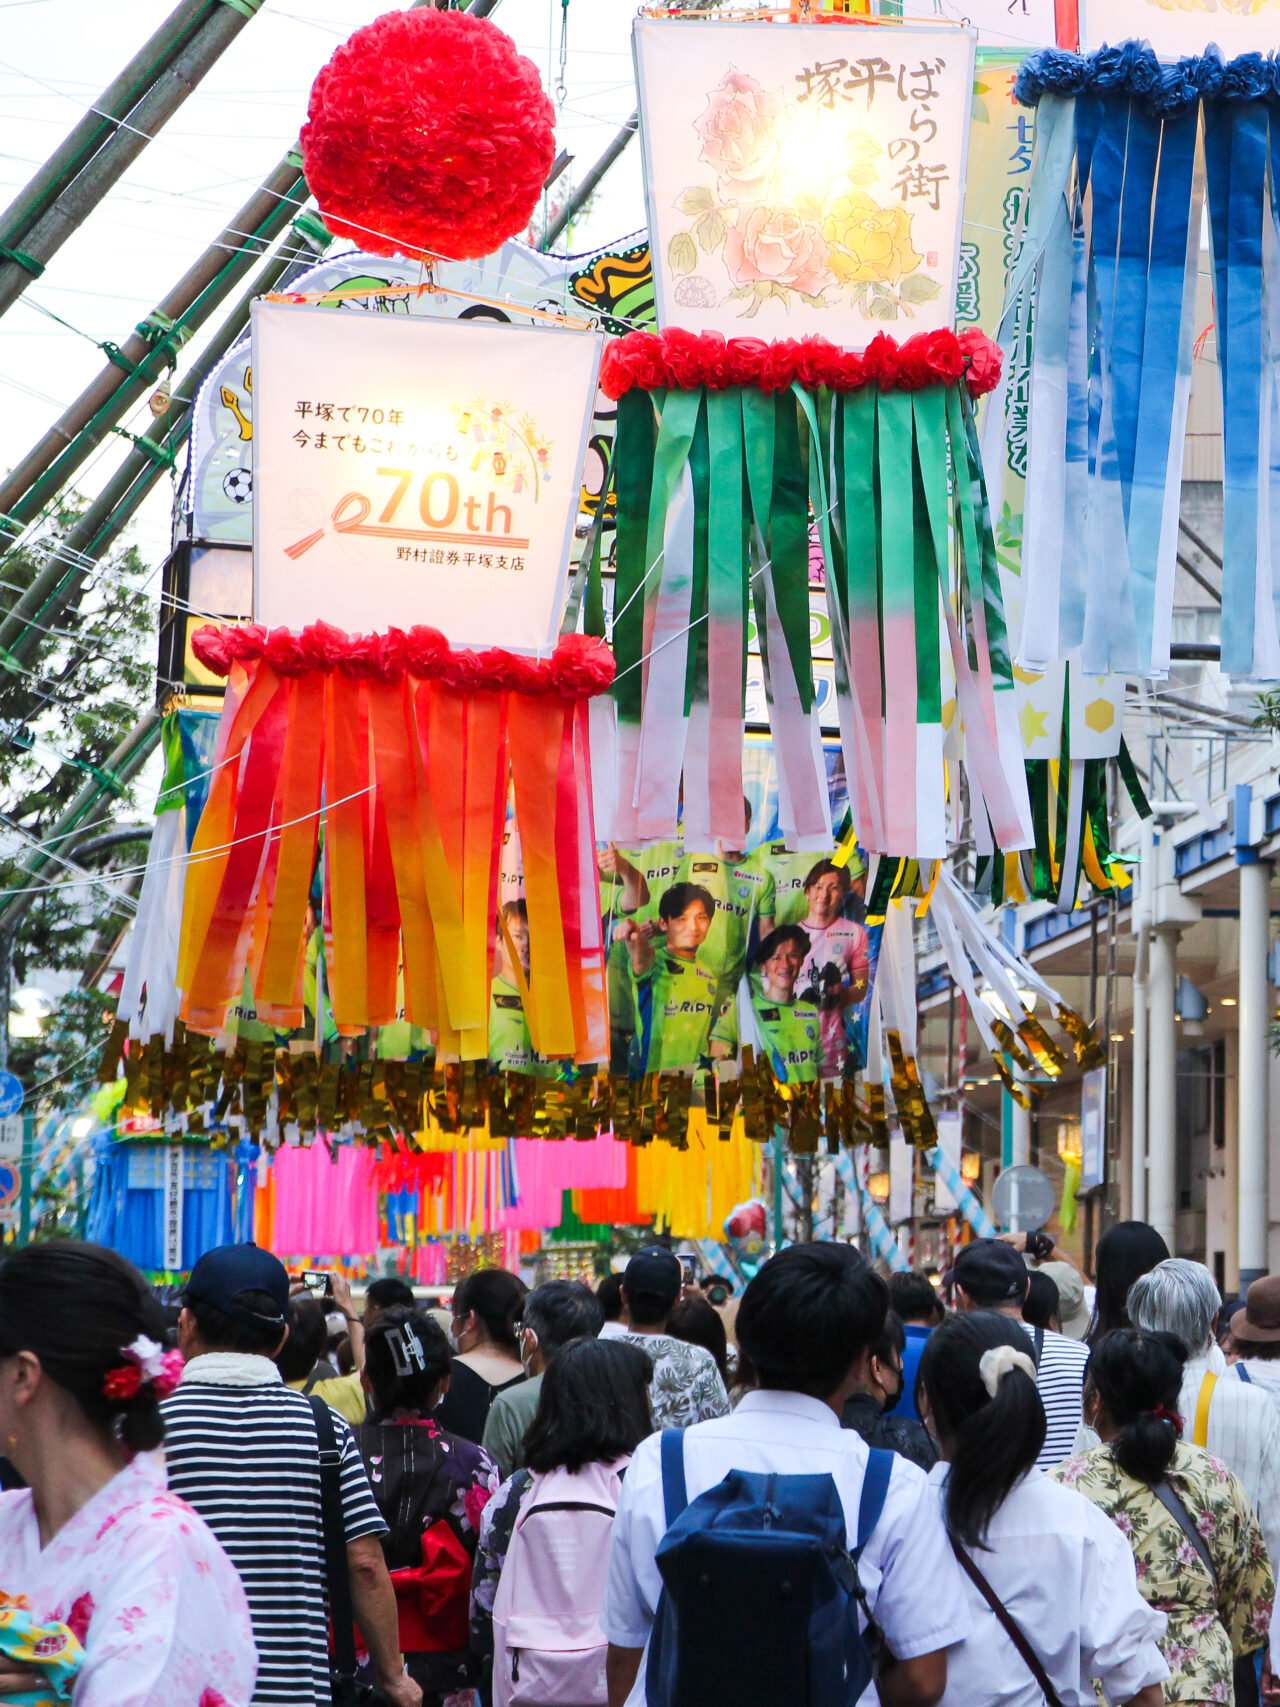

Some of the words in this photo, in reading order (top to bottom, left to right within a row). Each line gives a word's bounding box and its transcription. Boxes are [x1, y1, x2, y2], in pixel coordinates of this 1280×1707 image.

[294, 400, 405, 427] 平塚で70年
[375, 466, 512, 534] 70th
[396, 546, 526, 571] 野村證券平塚支店
